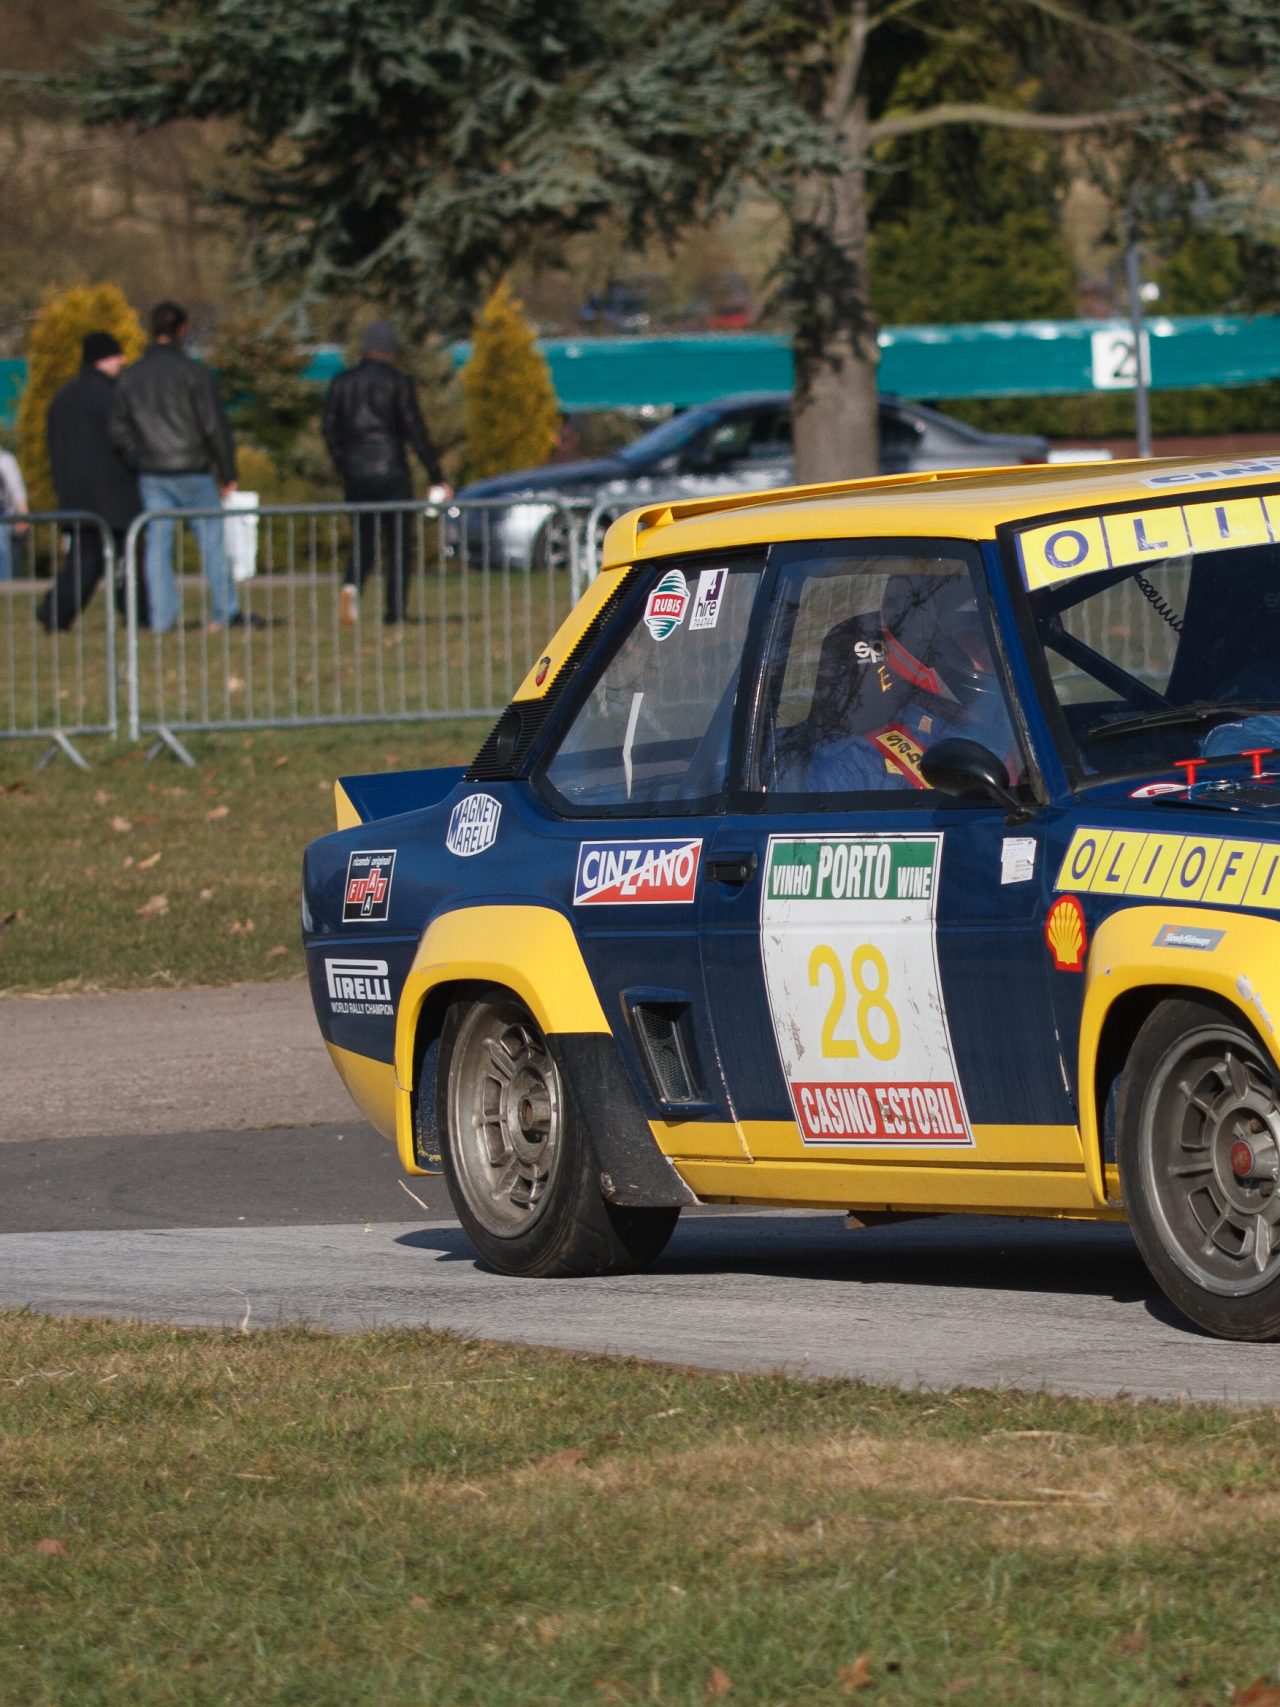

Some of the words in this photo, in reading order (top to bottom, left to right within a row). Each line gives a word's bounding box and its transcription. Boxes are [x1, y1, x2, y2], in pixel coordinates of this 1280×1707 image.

[1111, 341, 1136, 378] 2
[696, 598, 717, 619] hire
[449, 796, 500, 831] MAGNETI
[448, 819, 498, 852] MARELLI
[582, 849, 694, 896] CINZANO
[773, 864, 812, 896] VINHO
[815, 843, 892, 899] PORTO
[324, 958, 391, 1001] PIRELLI
[330, 1002, 349, 1013] WORLD
[349, 1003, 365, 1014] RALLY
[365, 1004, 394, 1015] CHAMPION
[807, 943, 901, 1062] 28
[801, 1088, 877, 1134] CASINO
[878, 1087, 964, 1136] ESTORIL
